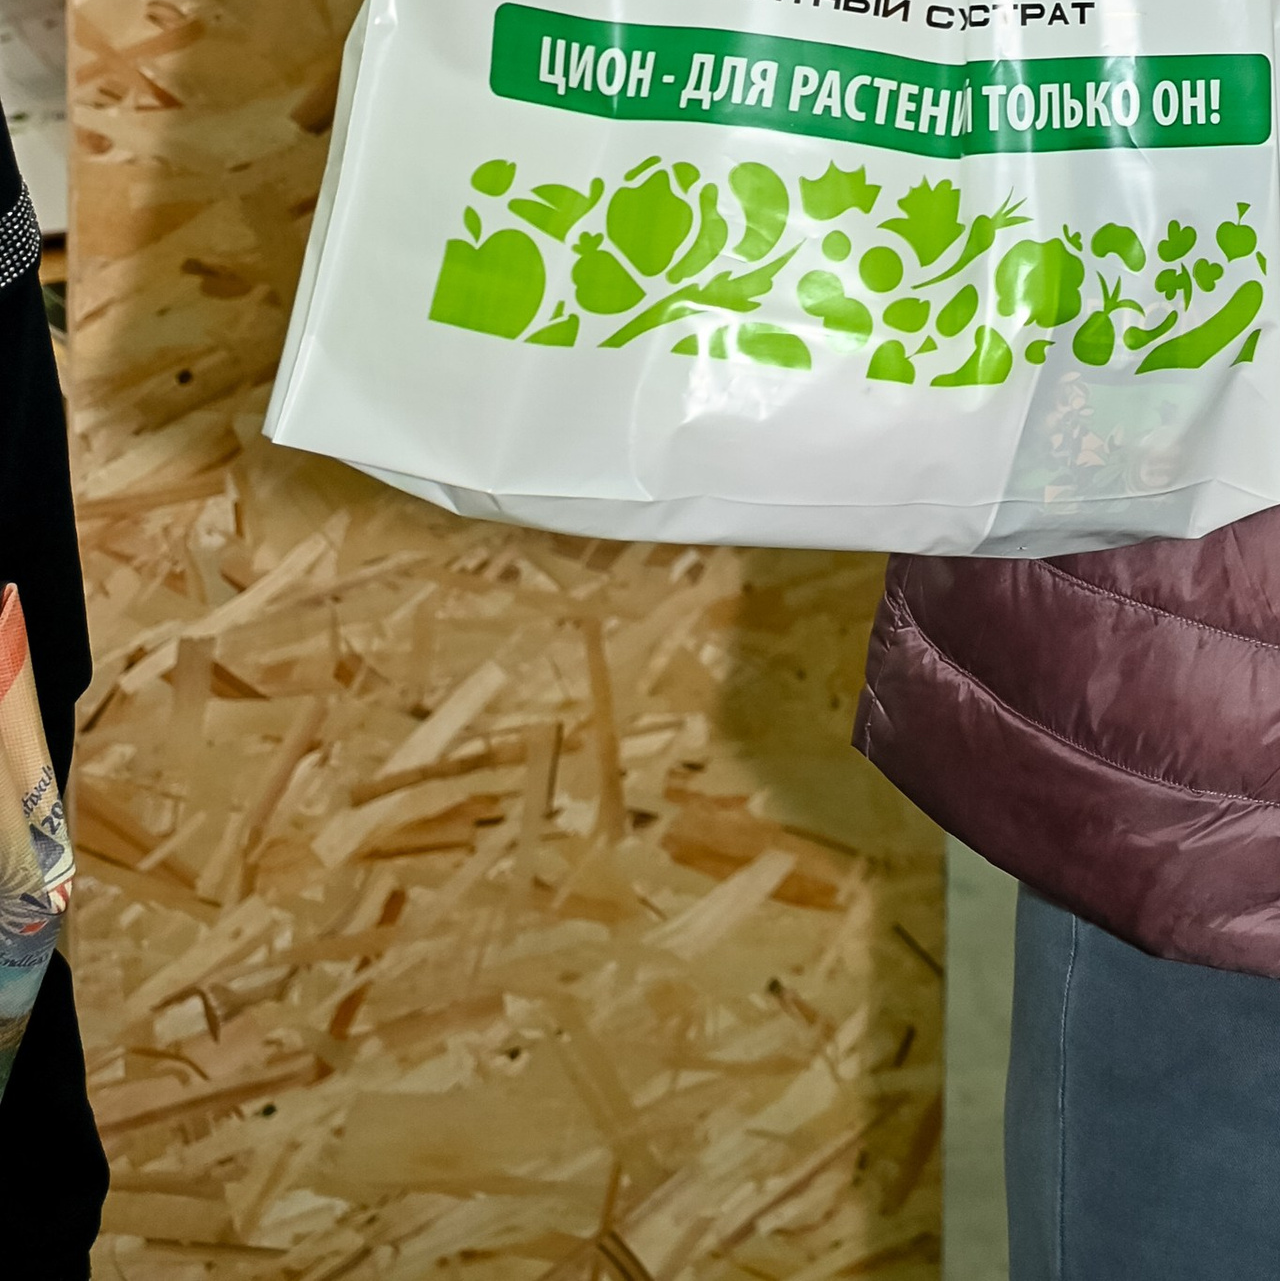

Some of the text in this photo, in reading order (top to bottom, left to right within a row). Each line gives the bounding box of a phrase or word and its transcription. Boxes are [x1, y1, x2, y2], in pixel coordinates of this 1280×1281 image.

[539, 36, 656, 96] ЦИОН
[679, 53, 779, 111] ДЛЯ
[982, 80, 1141, 132] ТОЛЬКО
[1152, 79, 1221, 125] ОН!
